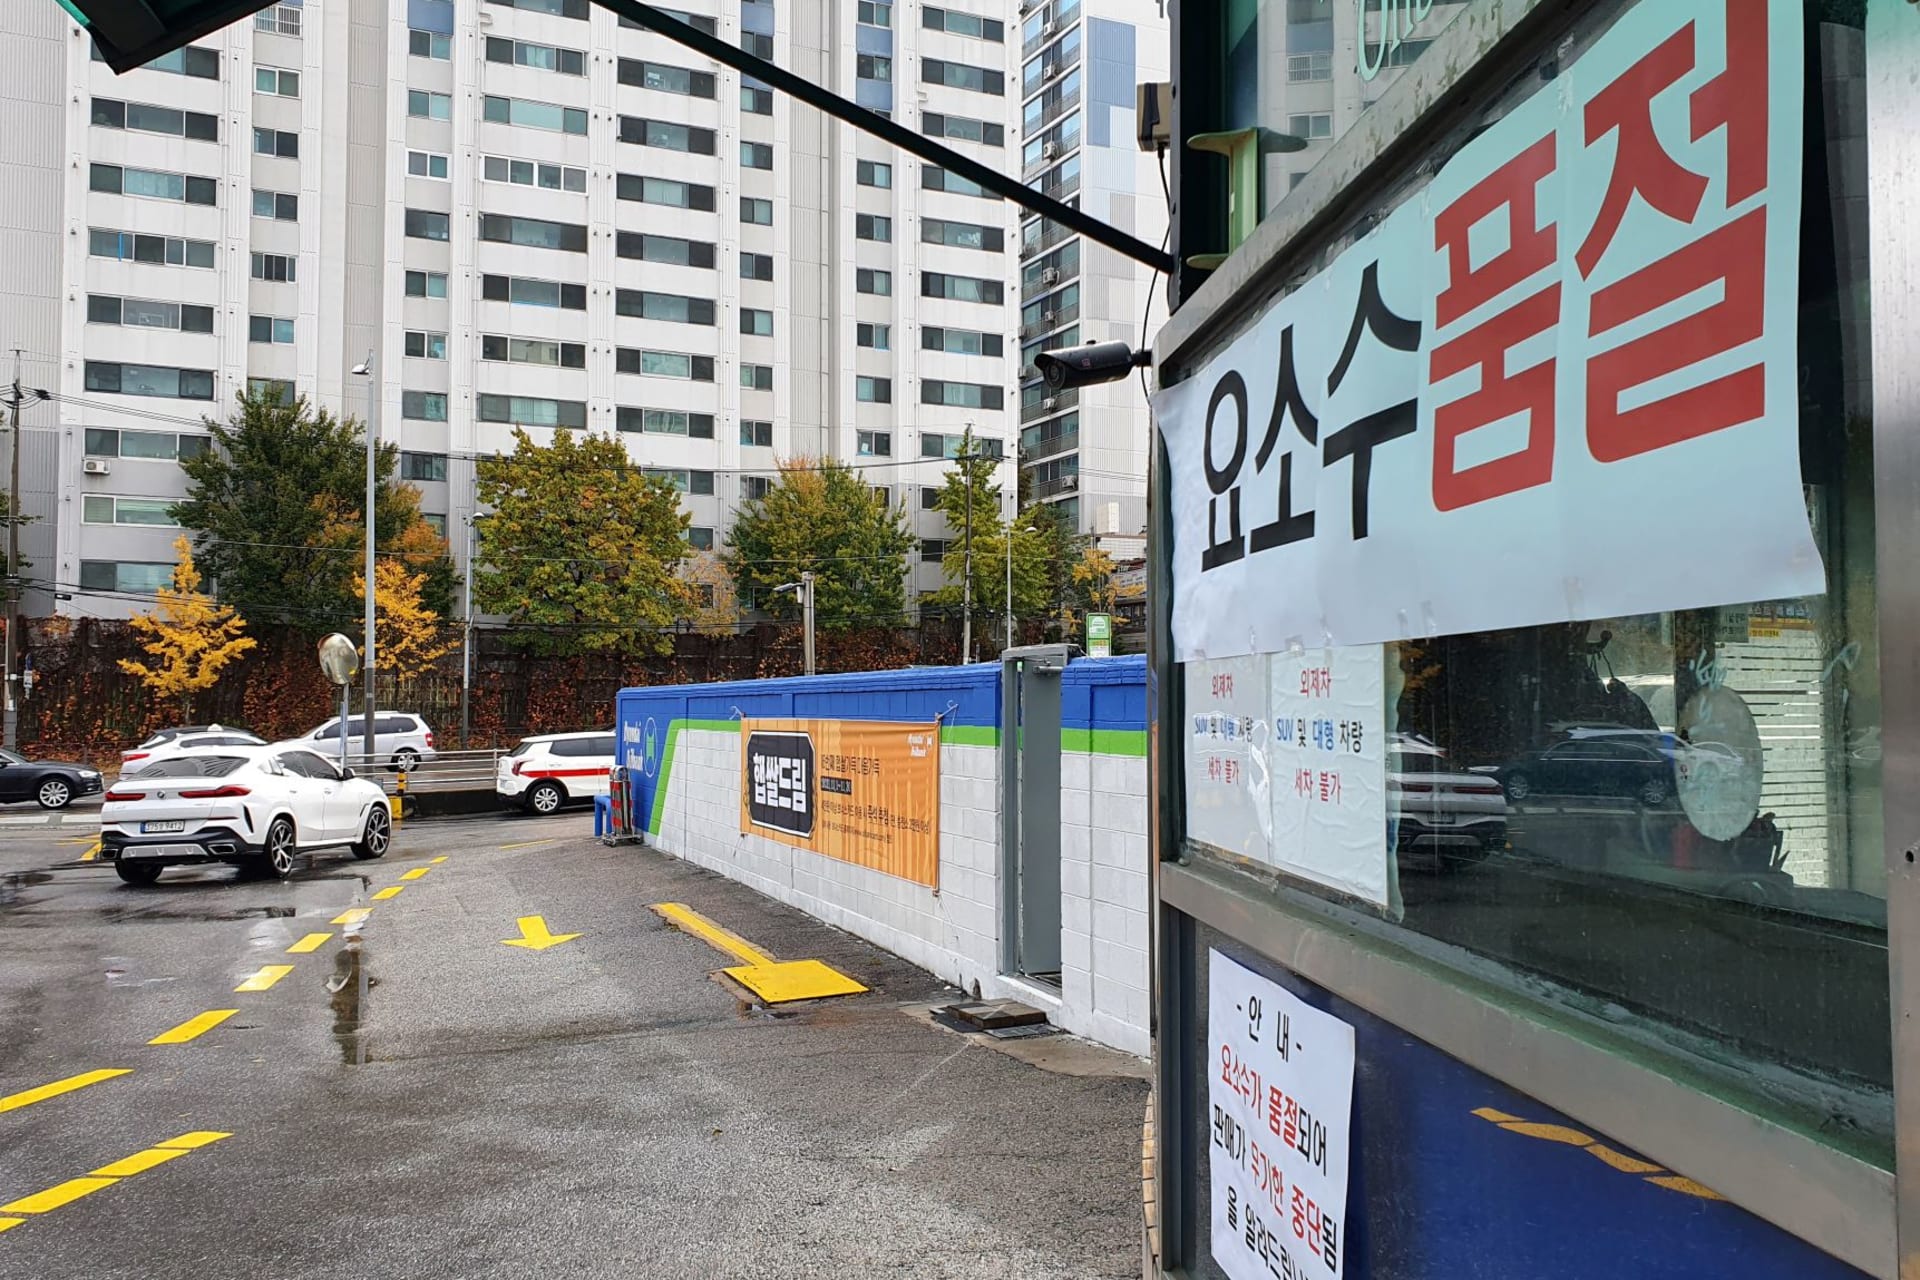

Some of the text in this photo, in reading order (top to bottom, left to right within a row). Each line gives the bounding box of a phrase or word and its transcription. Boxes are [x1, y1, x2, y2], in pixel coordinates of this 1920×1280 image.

[1212, 672, 1233, 698] 외제차
[1300, 667, 1332, 698] 외제차
[1276, 718, 1363, 753] SUV 및 대형 차량
[752, 752, 807, 813] 햅쌀드림
[1295, 768, 1342, 804] 세차 불가
[1222, 1044, 1327, 1177] 요소수가 품절되어
[1214, 1104, 1337, 1273] 판매가 무기한 중단됨
